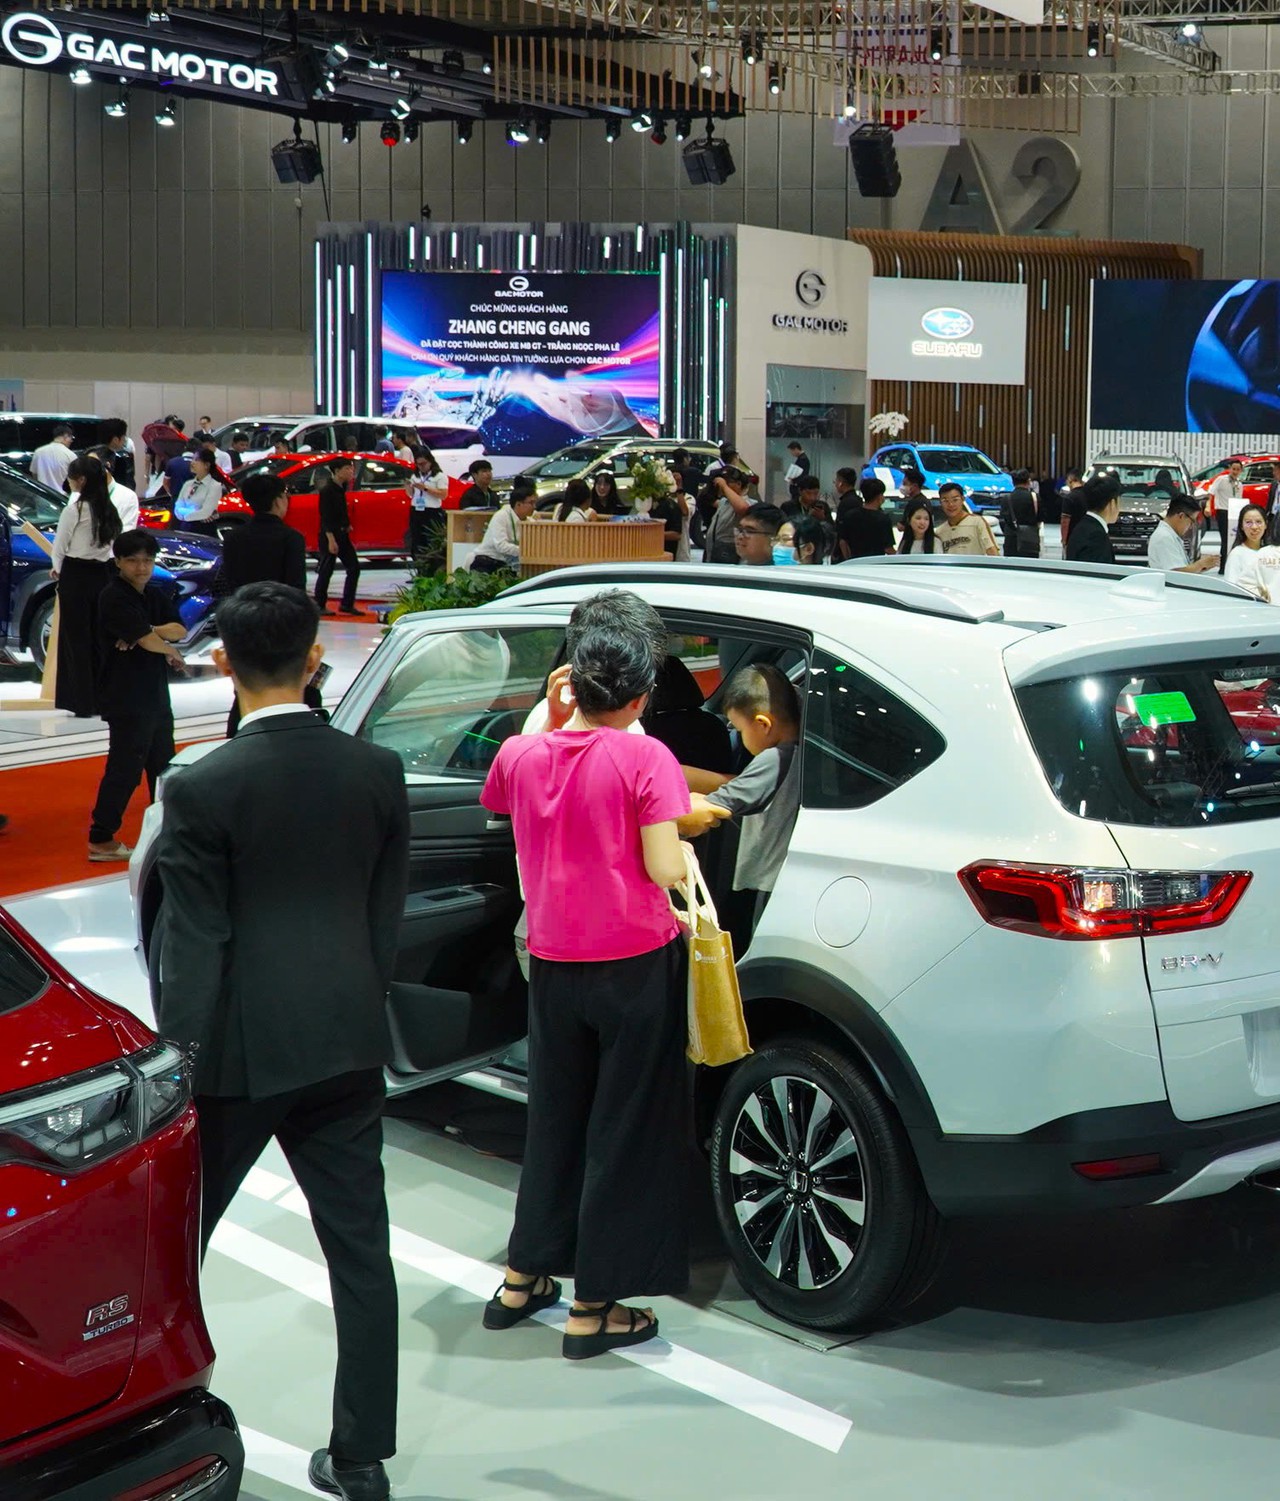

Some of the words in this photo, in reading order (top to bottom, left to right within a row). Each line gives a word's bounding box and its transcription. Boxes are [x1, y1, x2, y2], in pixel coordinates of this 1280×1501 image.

[67, 33, 146, 71] GAC
[151, 48, 279, 96] MOTOR
[919, 136, 1082, 238] A2
[494, 290, 513, 298] GAC
[513, 290, 544, 298] MOTOR
[518, 303, 545, 313] KHÁCH
[545, 304, 569, 314] HÀNG
[448, 320, 497, 334] ZHANG
[499, 320, 547, 336] CHENG
[549, 321, 590, 336] GANG
[772, 313, 802, 329] GAC
[802, 316, 849, 334] MOTOR
[488, 340, 509, 350] CÔNG
[509, 342, 519, 350] XE
[594, 343, 610, 351] PHA
[610, 342, 620, 352] LÊ
[911, 340, 983, 357] SUBARU
[586, 356, 602, 365] GAC
[603, 357, 631, 366] MOTOR
[1160, 952, 1225, 971] BR-V
[86, 1294, 129, 1327] RS
[89, 1317, 129, 1337] TURBO
